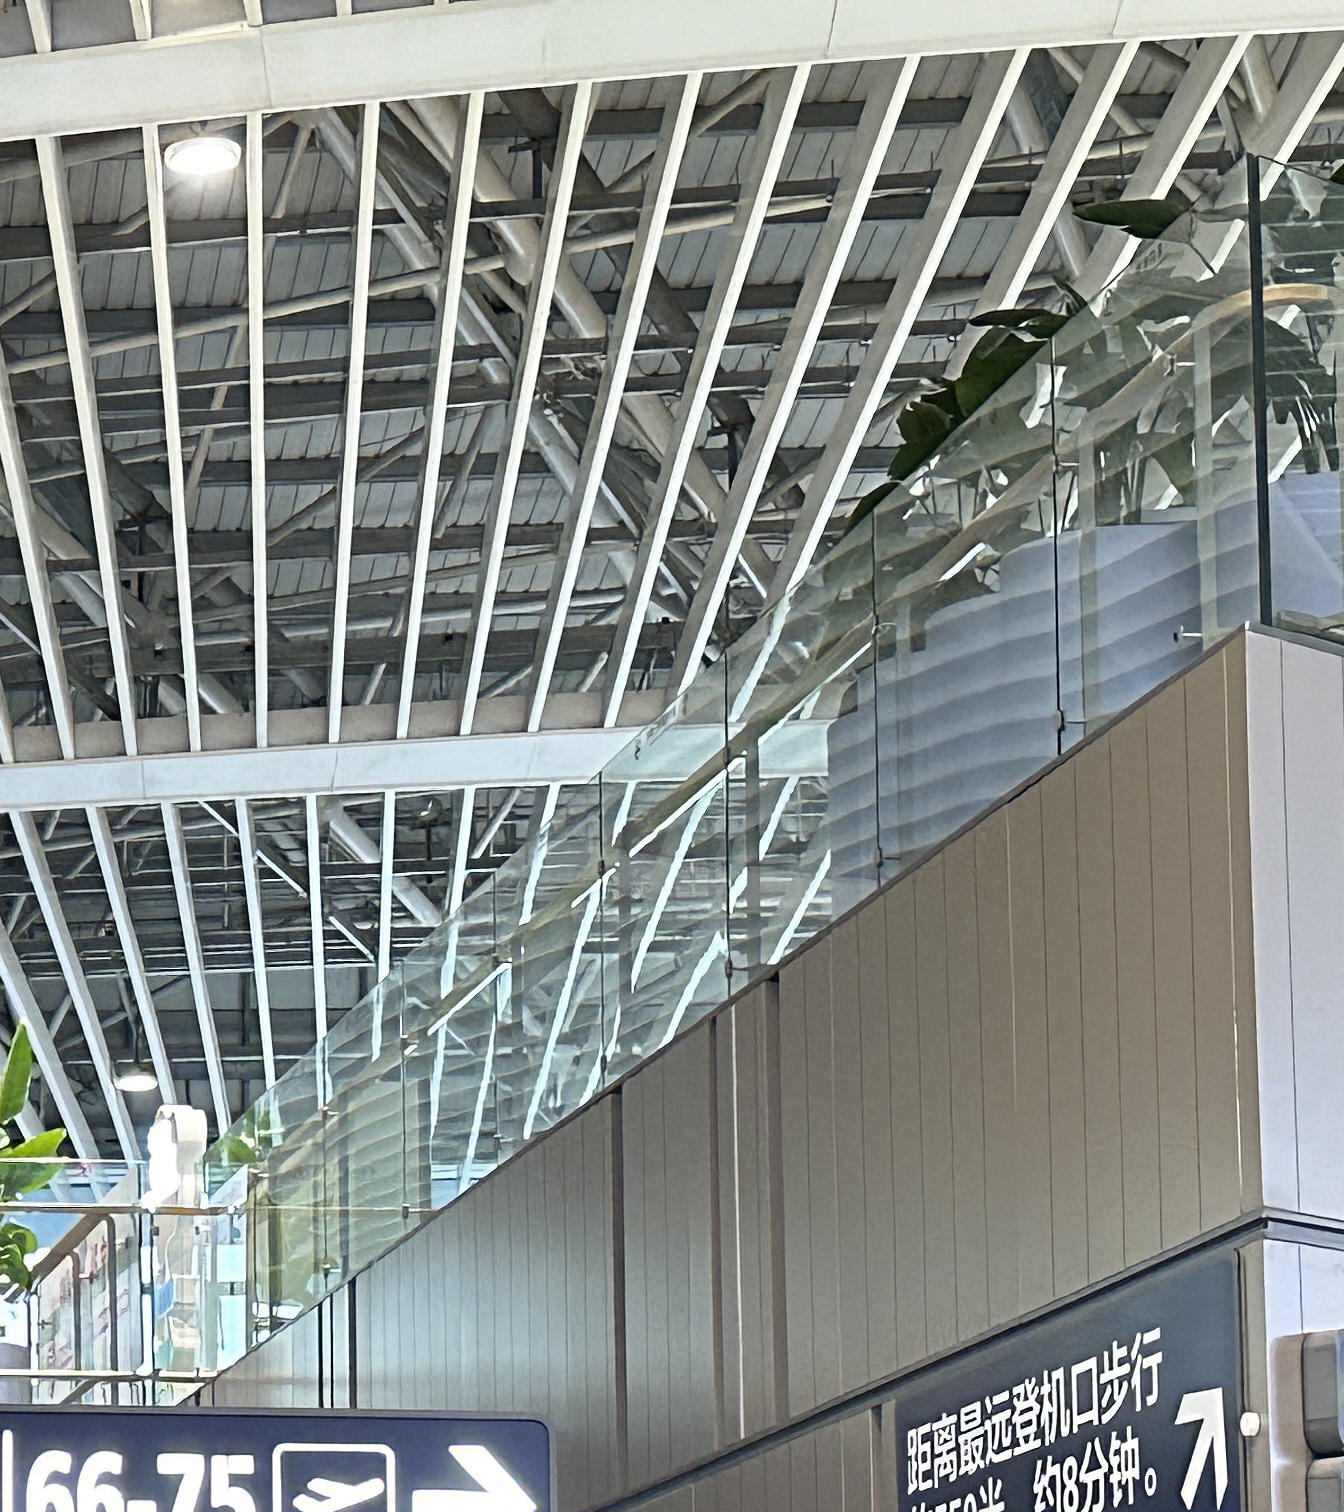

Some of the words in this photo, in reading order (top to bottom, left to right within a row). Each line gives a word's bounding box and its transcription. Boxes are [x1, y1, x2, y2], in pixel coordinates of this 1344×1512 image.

[907, 1326, 1163, 1495] 距离最远登机口步行
